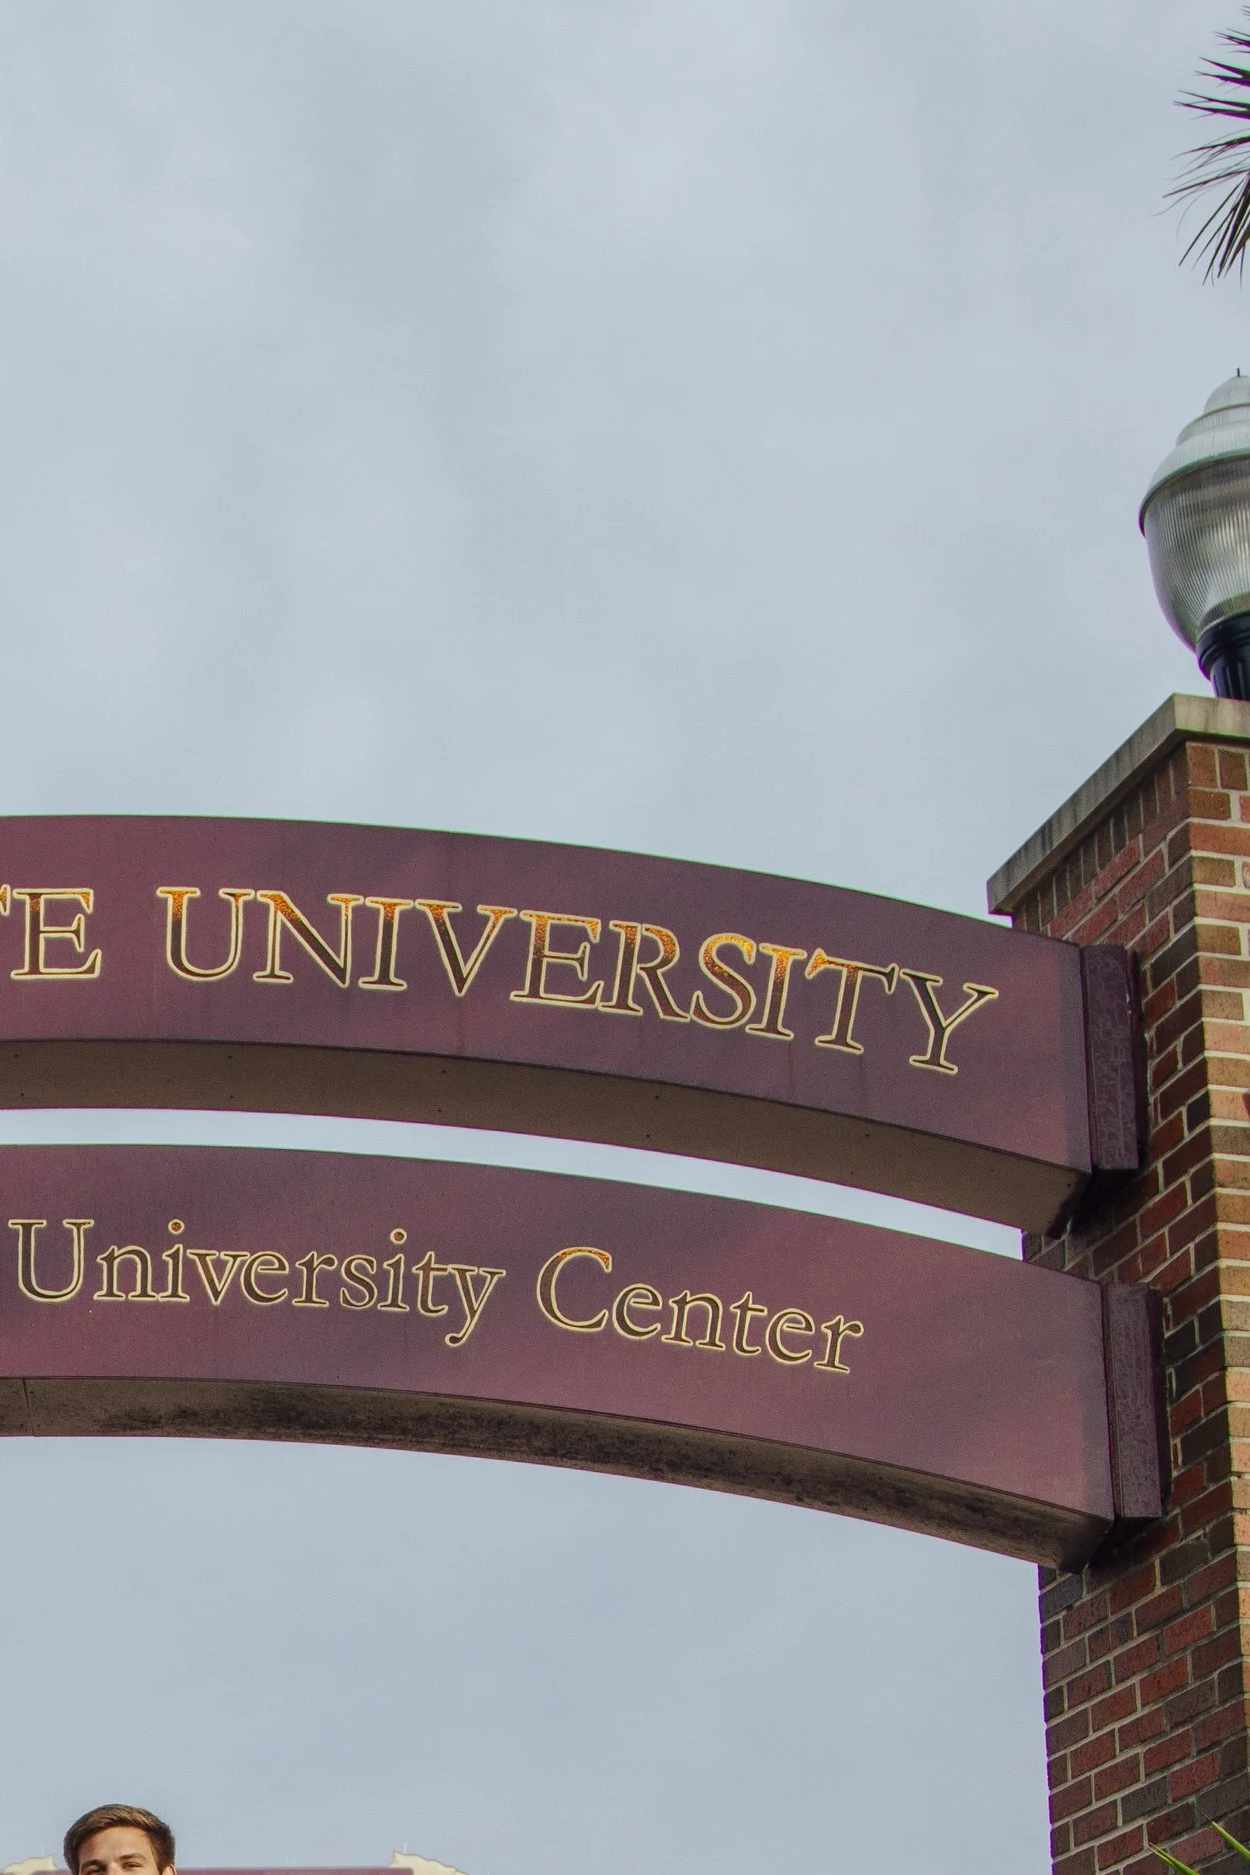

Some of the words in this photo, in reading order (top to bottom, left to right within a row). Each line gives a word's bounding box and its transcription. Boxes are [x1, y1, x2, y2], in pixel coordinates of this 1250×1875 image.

[156, 886, 999, 1074] UNIVERSITY
[8, 1218, 506, 1345] University
[536, 1247, 864, 1374] Center
